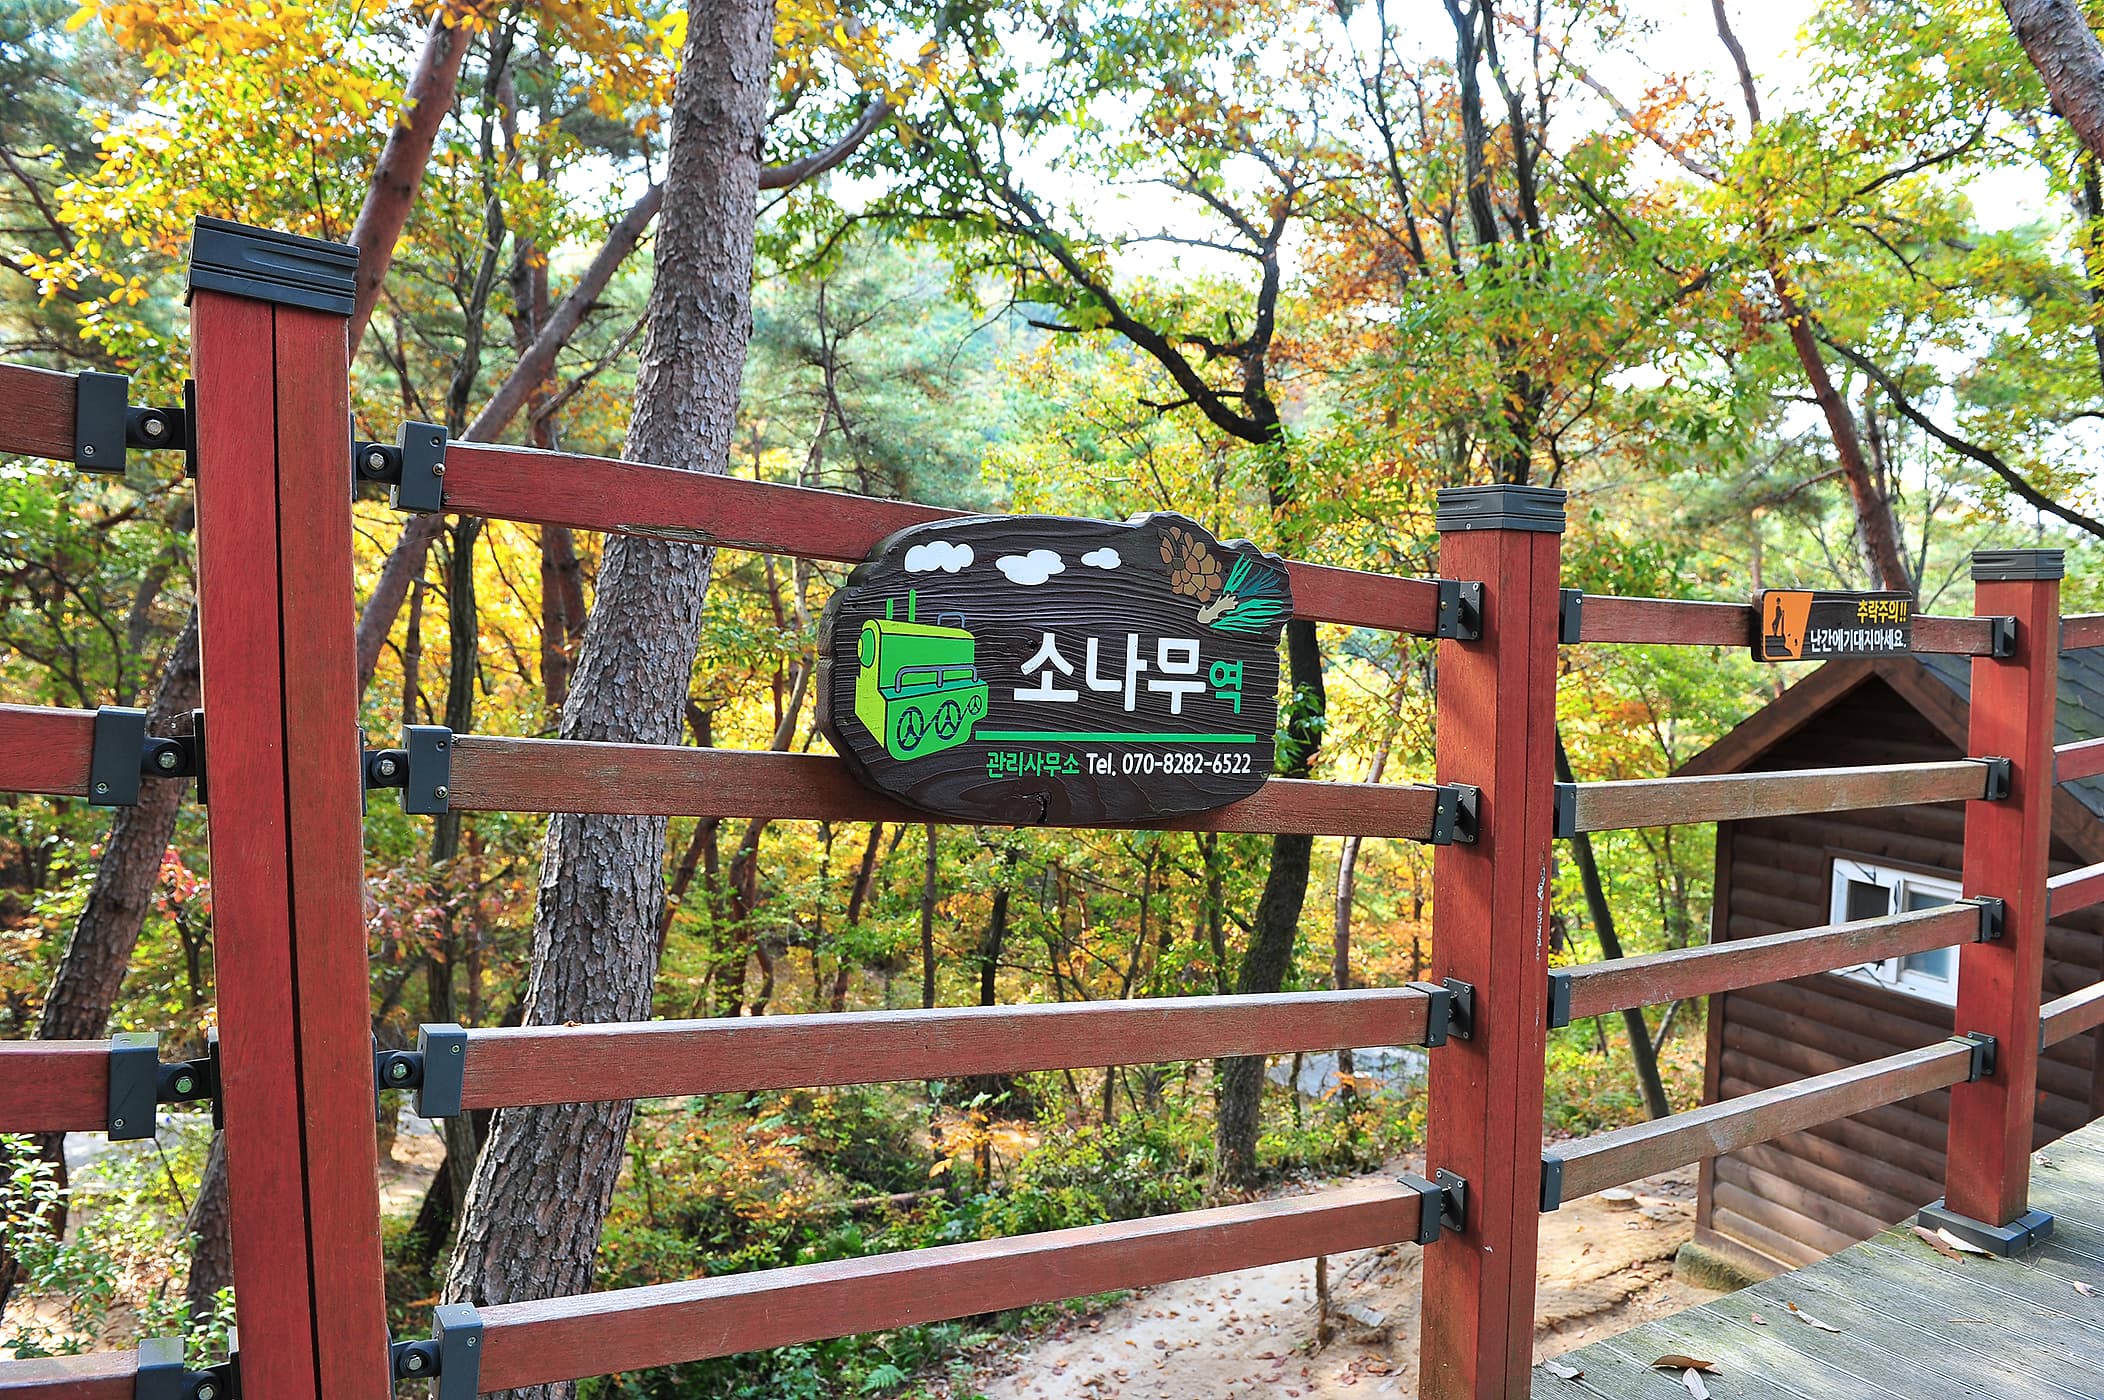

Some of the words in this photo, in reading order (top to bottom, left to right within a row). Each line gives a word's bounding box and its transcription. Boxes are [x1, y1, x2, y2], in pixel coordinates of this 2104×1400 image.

[1856, 599, 1907, 624] 추락주의!!
[985, 751, 1080, 779] 관리사무소
[1086, 752, 1117, 777] Tel.
[1122, 752, 1251, 775] 070-8282-6522
